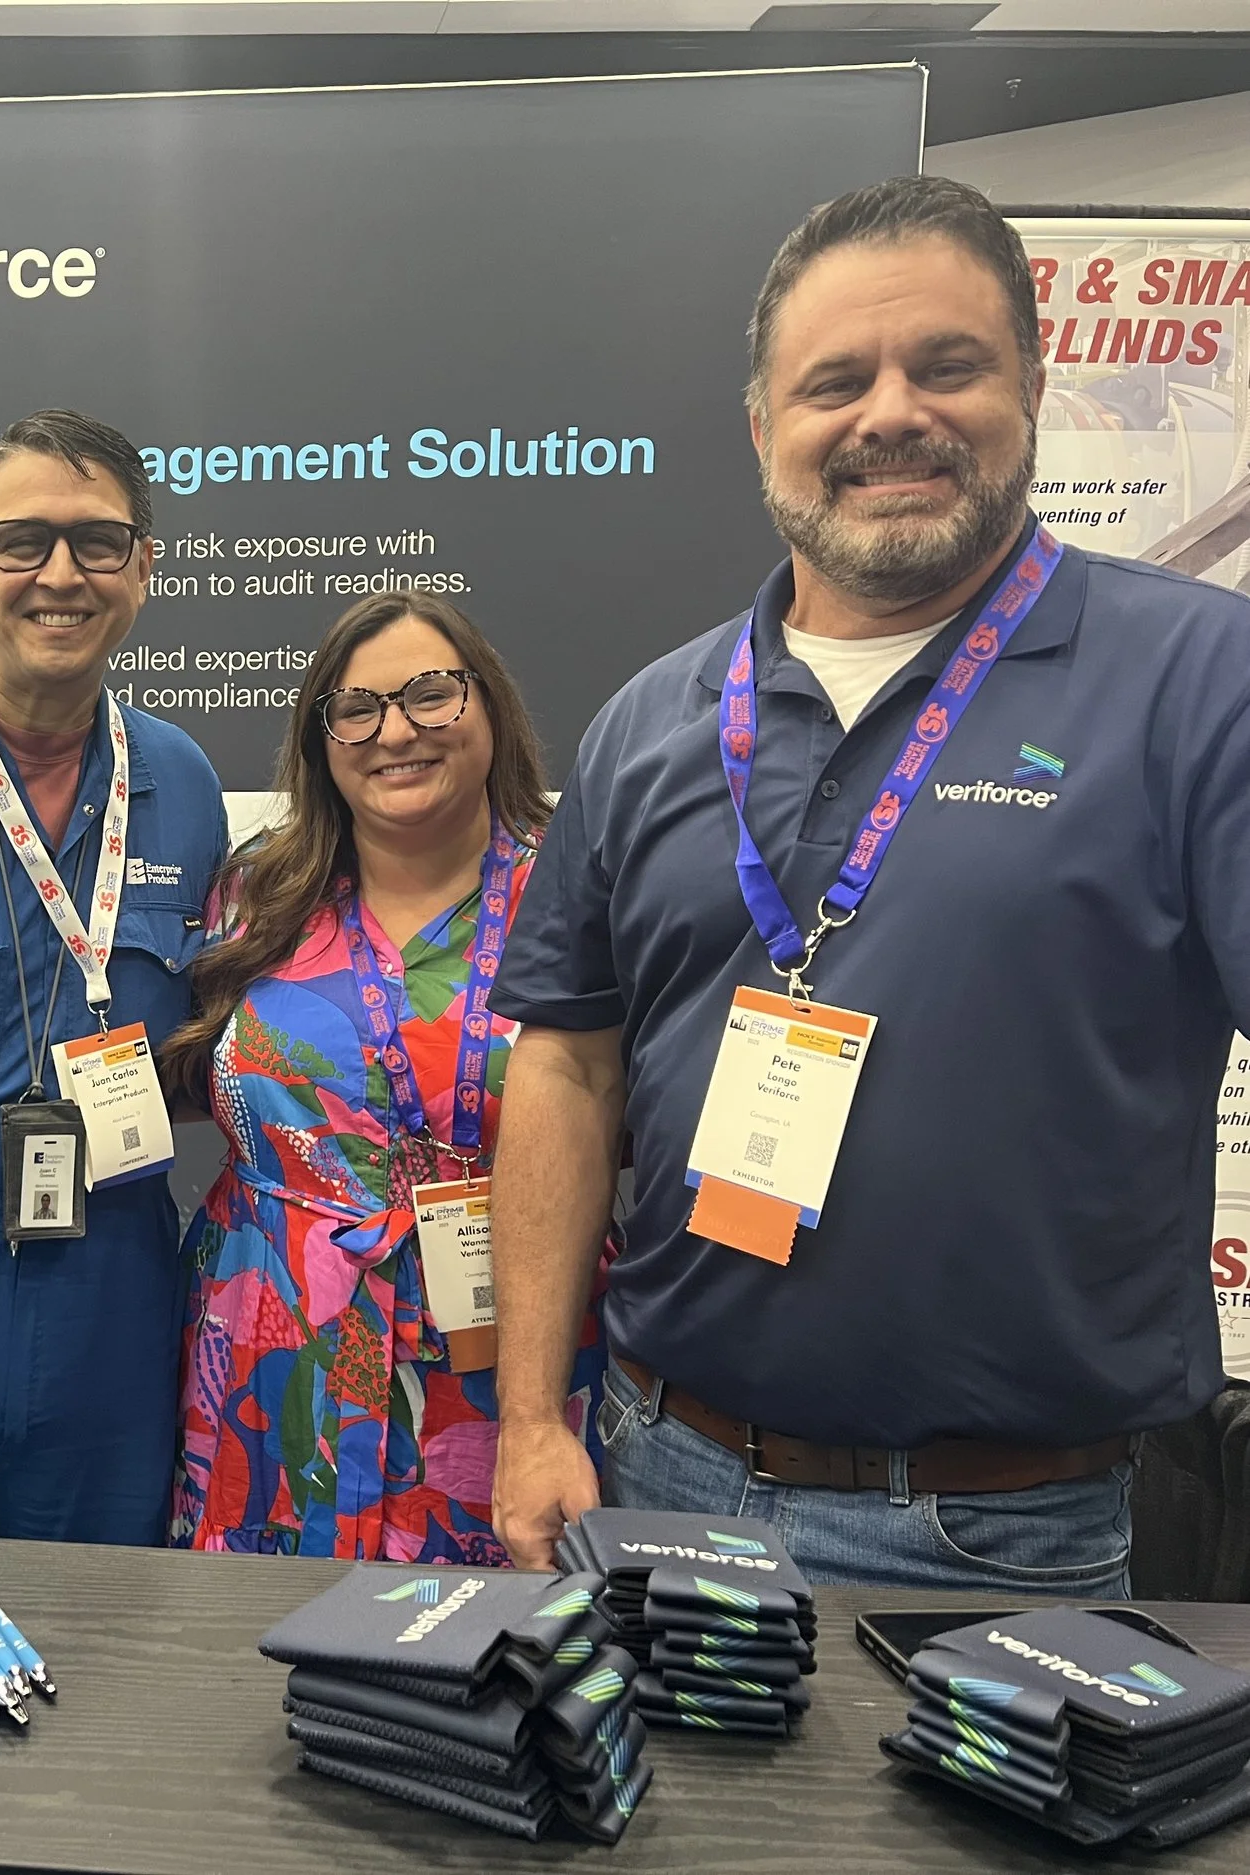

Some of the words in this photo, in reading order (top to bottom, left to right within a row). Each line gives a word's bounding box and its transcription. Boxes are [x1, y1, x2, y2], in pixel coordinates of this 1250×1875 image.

[1076, 257, 1118, 305] &
[1137, 258, 1250, 306] SMA
[138, 434, 390, 495] agement
[408, 426, 654, 479] Solution
[1030, 481, 1066, 494] eam
[1072, 479, 1117, 494] work
[1121, 479, 1168, 495] safer
[1107, 508, 1128, 524] of
[175, 532, 226, 559] risk
[234, 534, 367, 563] exposure
[376, 528, 436, 556] with
[208, 571, 236, 597] to
[244, 569, 315, 597] audit
[324, 567, 472, 595] readiness.
[919, 703, 948, 733] 3S
[874, 790, 900, 821] 3S
[10, 824, 31, 847] 3S
[39, 879, 59, 901] 3S
[772, 1055, 802, 1072] Pete
[91, 1075, 111, 1088] Juan
[112, 1068, 139, 1081] Carlos
[767, 1071, 798, 1087] Longo
[93, 1096, 123, 1109] Enterprise
[123, 1087, 149, 1100] Products
[107, 1084, 129, 1094] Gomez
[757, 1082, 801, 1102] Veriforce
[1224, 1086, 1245, 1097] on
[732, 1169, 775, 1188] EXHIBITOR
[457, 1225, 491, 1237] Alliso
